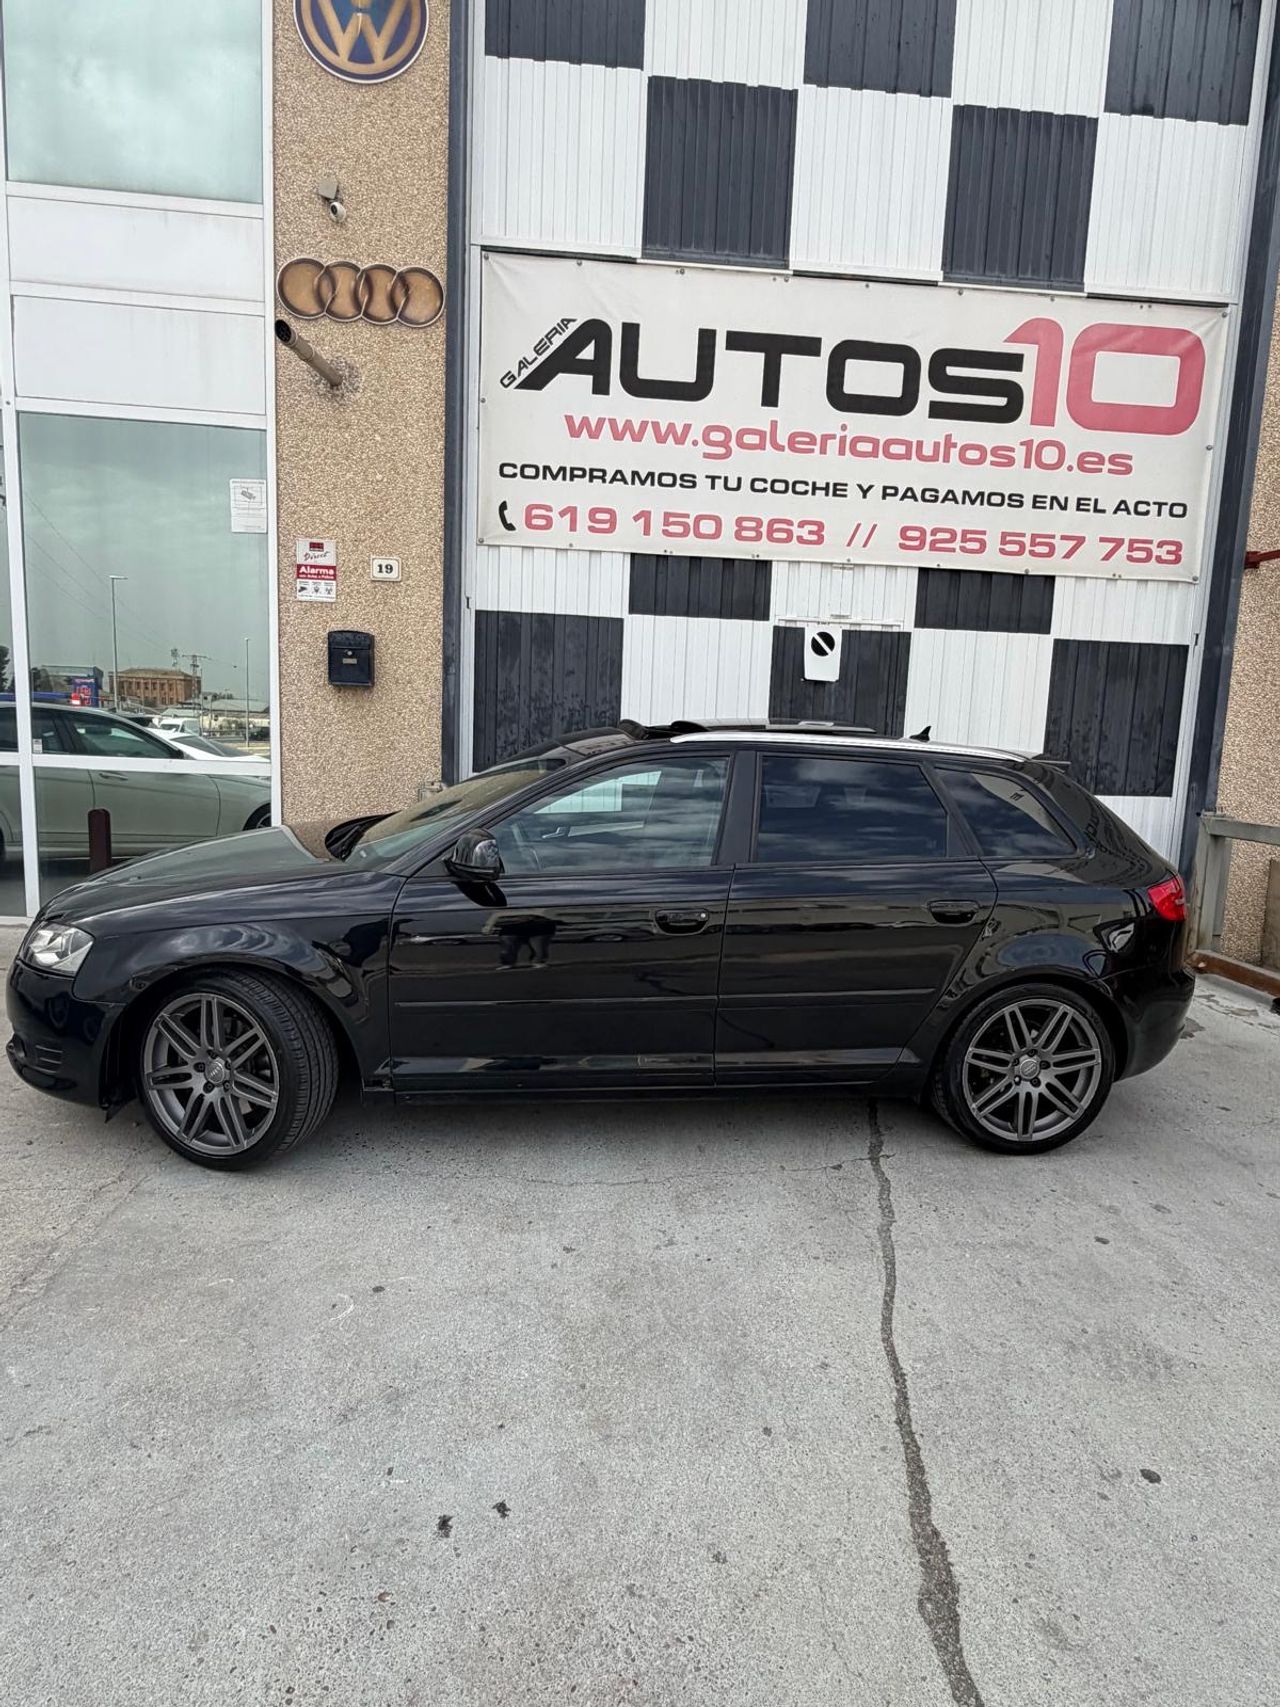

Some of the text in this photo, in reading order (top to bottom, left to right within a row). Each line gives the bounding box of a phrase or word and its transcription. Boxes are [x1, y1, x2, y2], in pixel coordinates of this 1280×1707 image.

[499, 317, 577, 389] GALERIA
[564, 414, 1133, 477] www.galeriaautos10.es
[498, 462, 1188, 519] COMPRAMOS TU COCHE Y PAGAMOS EN EL ACTO
[523, 503, 618, 535] 619
[632, 509, 722, 541] 150
[733, 515, 826, 546] 863
[898, 524, 988, 555] 925
[998, 530, 1087, 561] 557
[1098, 535, 1184, 566] 753
[300, 565, 335, 576] Alarma
[377, 563, 394, 575] 19
